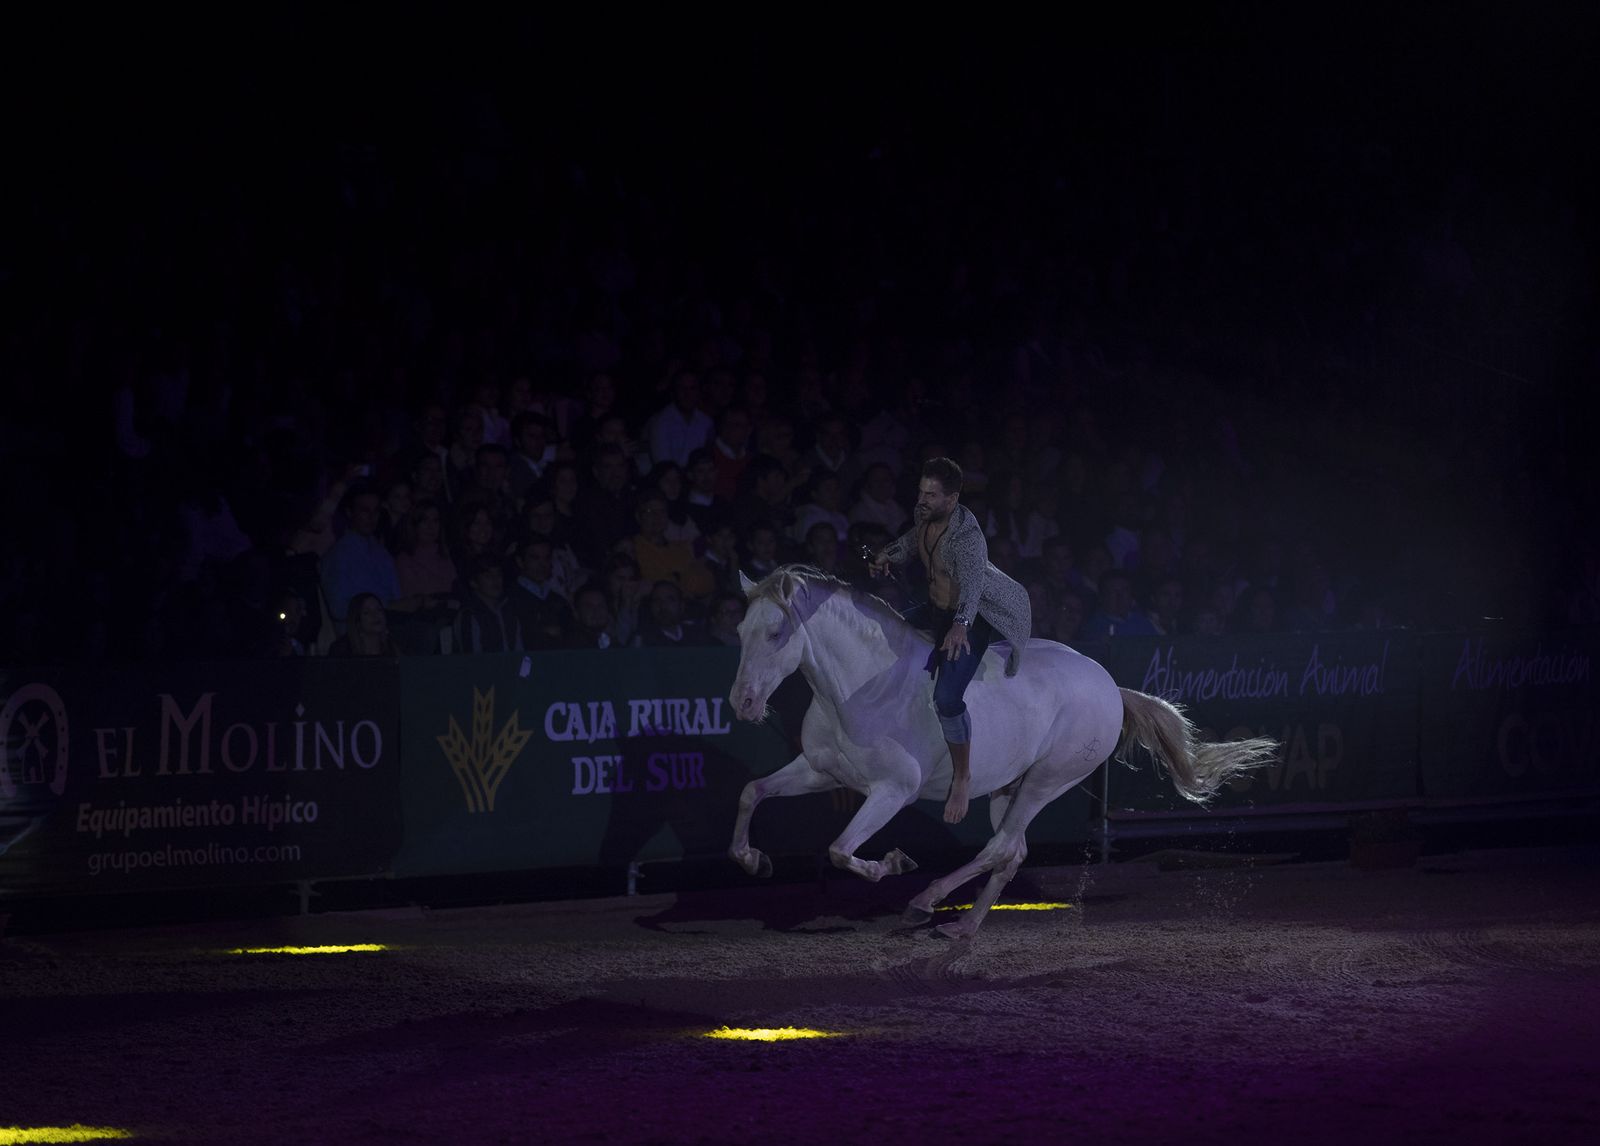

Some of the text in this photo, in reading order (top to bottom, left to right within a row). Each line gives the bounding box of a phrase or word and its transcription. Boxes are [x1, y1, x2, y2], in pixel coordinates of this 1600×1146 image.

[1142, 640, 1390, 702] Alimentación Animal
[544, 697, 731, 744] CAJA RURAL
[93, 726, 142, 778] EL
[572, 752, 705, 795] DEL SUR
[76, 794, 319, 838] Equipamiento Hípico
[87, 843, 301, 875] grupoelmolino.com
